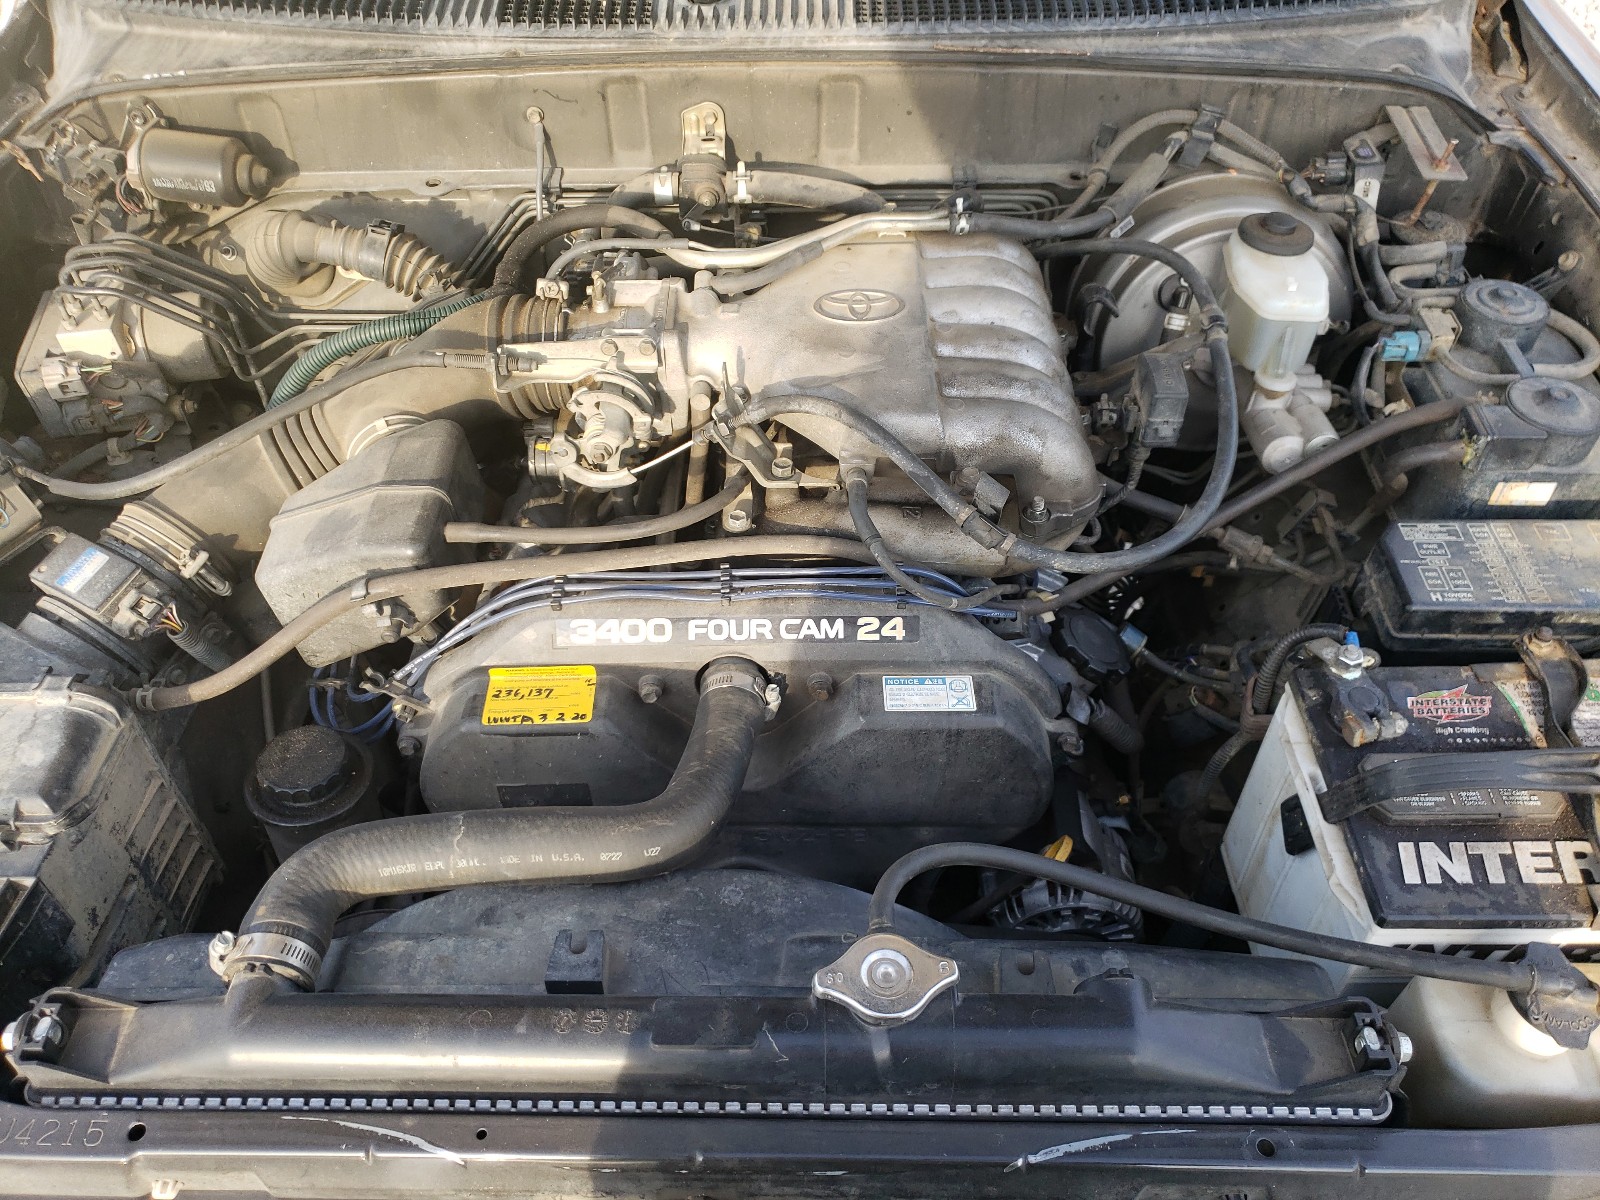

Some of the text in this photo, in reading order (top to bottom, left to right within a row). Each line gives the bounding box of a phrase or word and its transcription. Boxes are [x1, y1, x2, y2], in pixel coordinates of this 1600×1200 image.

[569, 616, 906, 644] 3400 FOUR CAM 24
[1409, 697, 1487, 706] INTERSTATE
[1417, 706, 1487, 715] BATTERIES
[556, 712, 566, 722] 2
[1435, 726, 1490, 735] High Cranking
[531, 854, 543, 862] IN
[552, 853, 585, 862] U.S.A.
[1398, 841, 1600, 884] INTER
